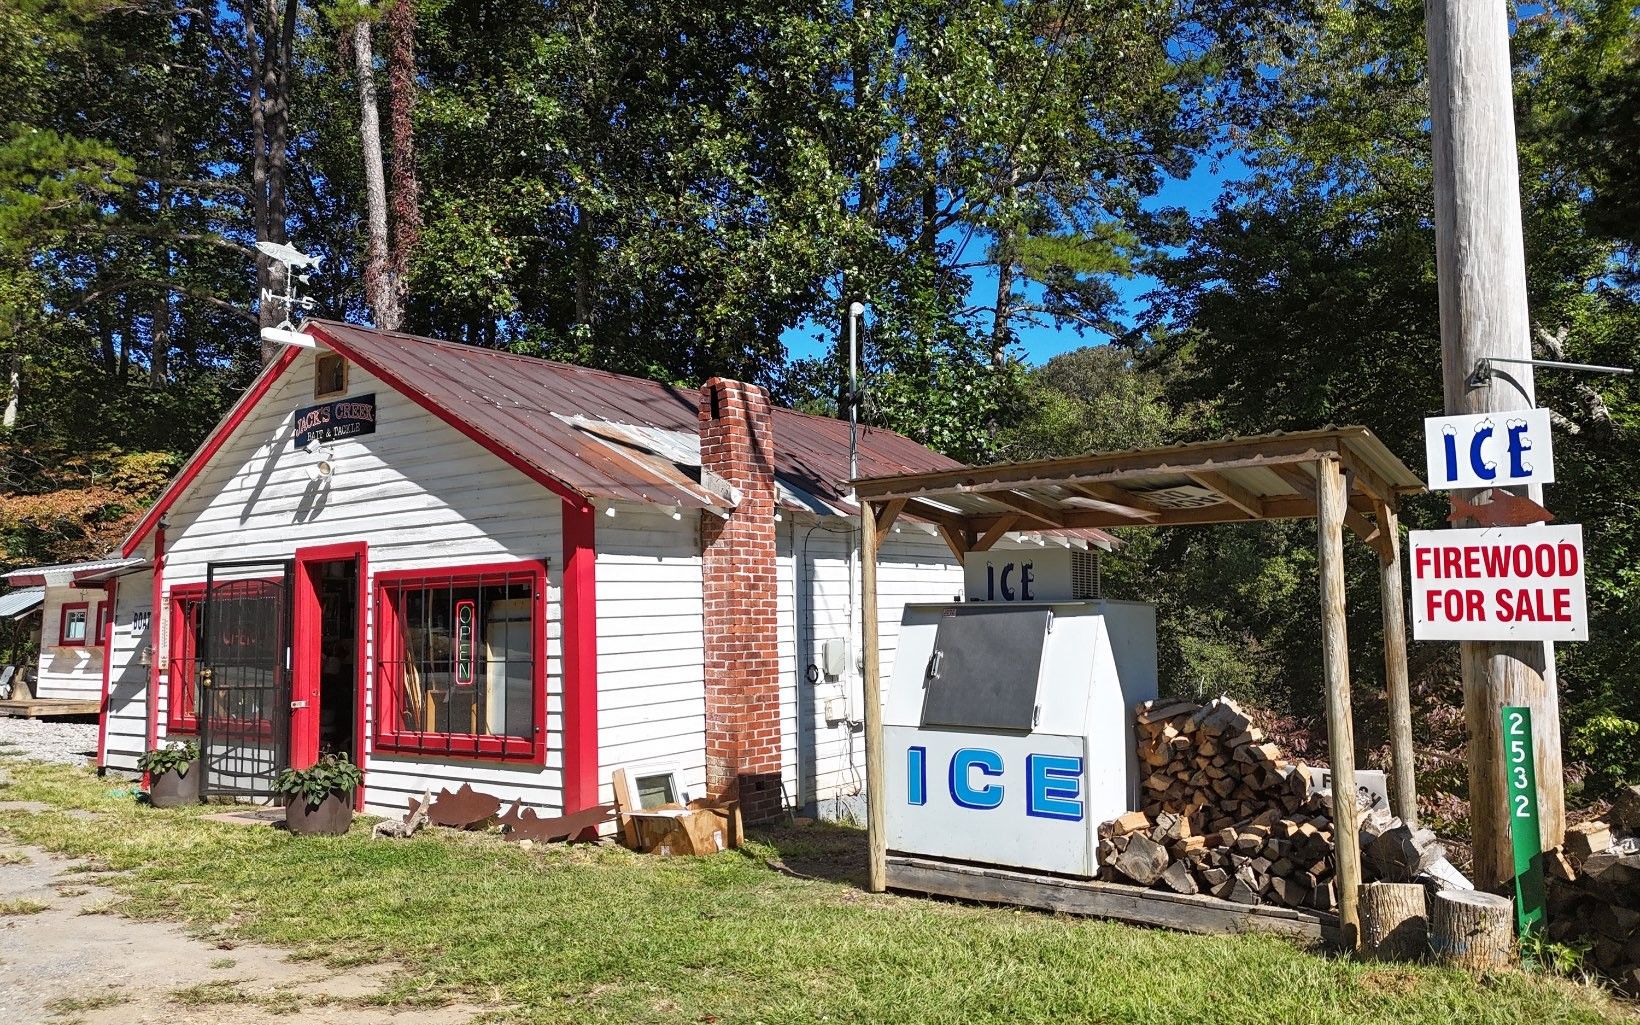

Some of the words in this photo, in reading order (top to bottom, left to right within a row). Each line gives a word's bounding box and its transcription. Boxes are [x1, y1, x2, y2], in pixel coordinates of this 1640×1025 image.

[295, 406, 330, 437] JACK'S
[335, 403, 374, 422] CREEK
[307, 430, 324, 441] BAIT
[326, 428, 331, 437] &
[334, 422, 361, 436] TACKLE
[1441, 417, 1534, 482] ICE
[986, 559, 1035, 601] ICE
[1415, 543, 1579, 579] FIREWOOD
[1426, 589, 1487, 622] FOR
[1495, 588, 1572, 622] SALE
[460, 605, 471, 678] OPEN
[907, 746, 1084, 822] ICE
[1509, 713, 1530, 817] 2532
